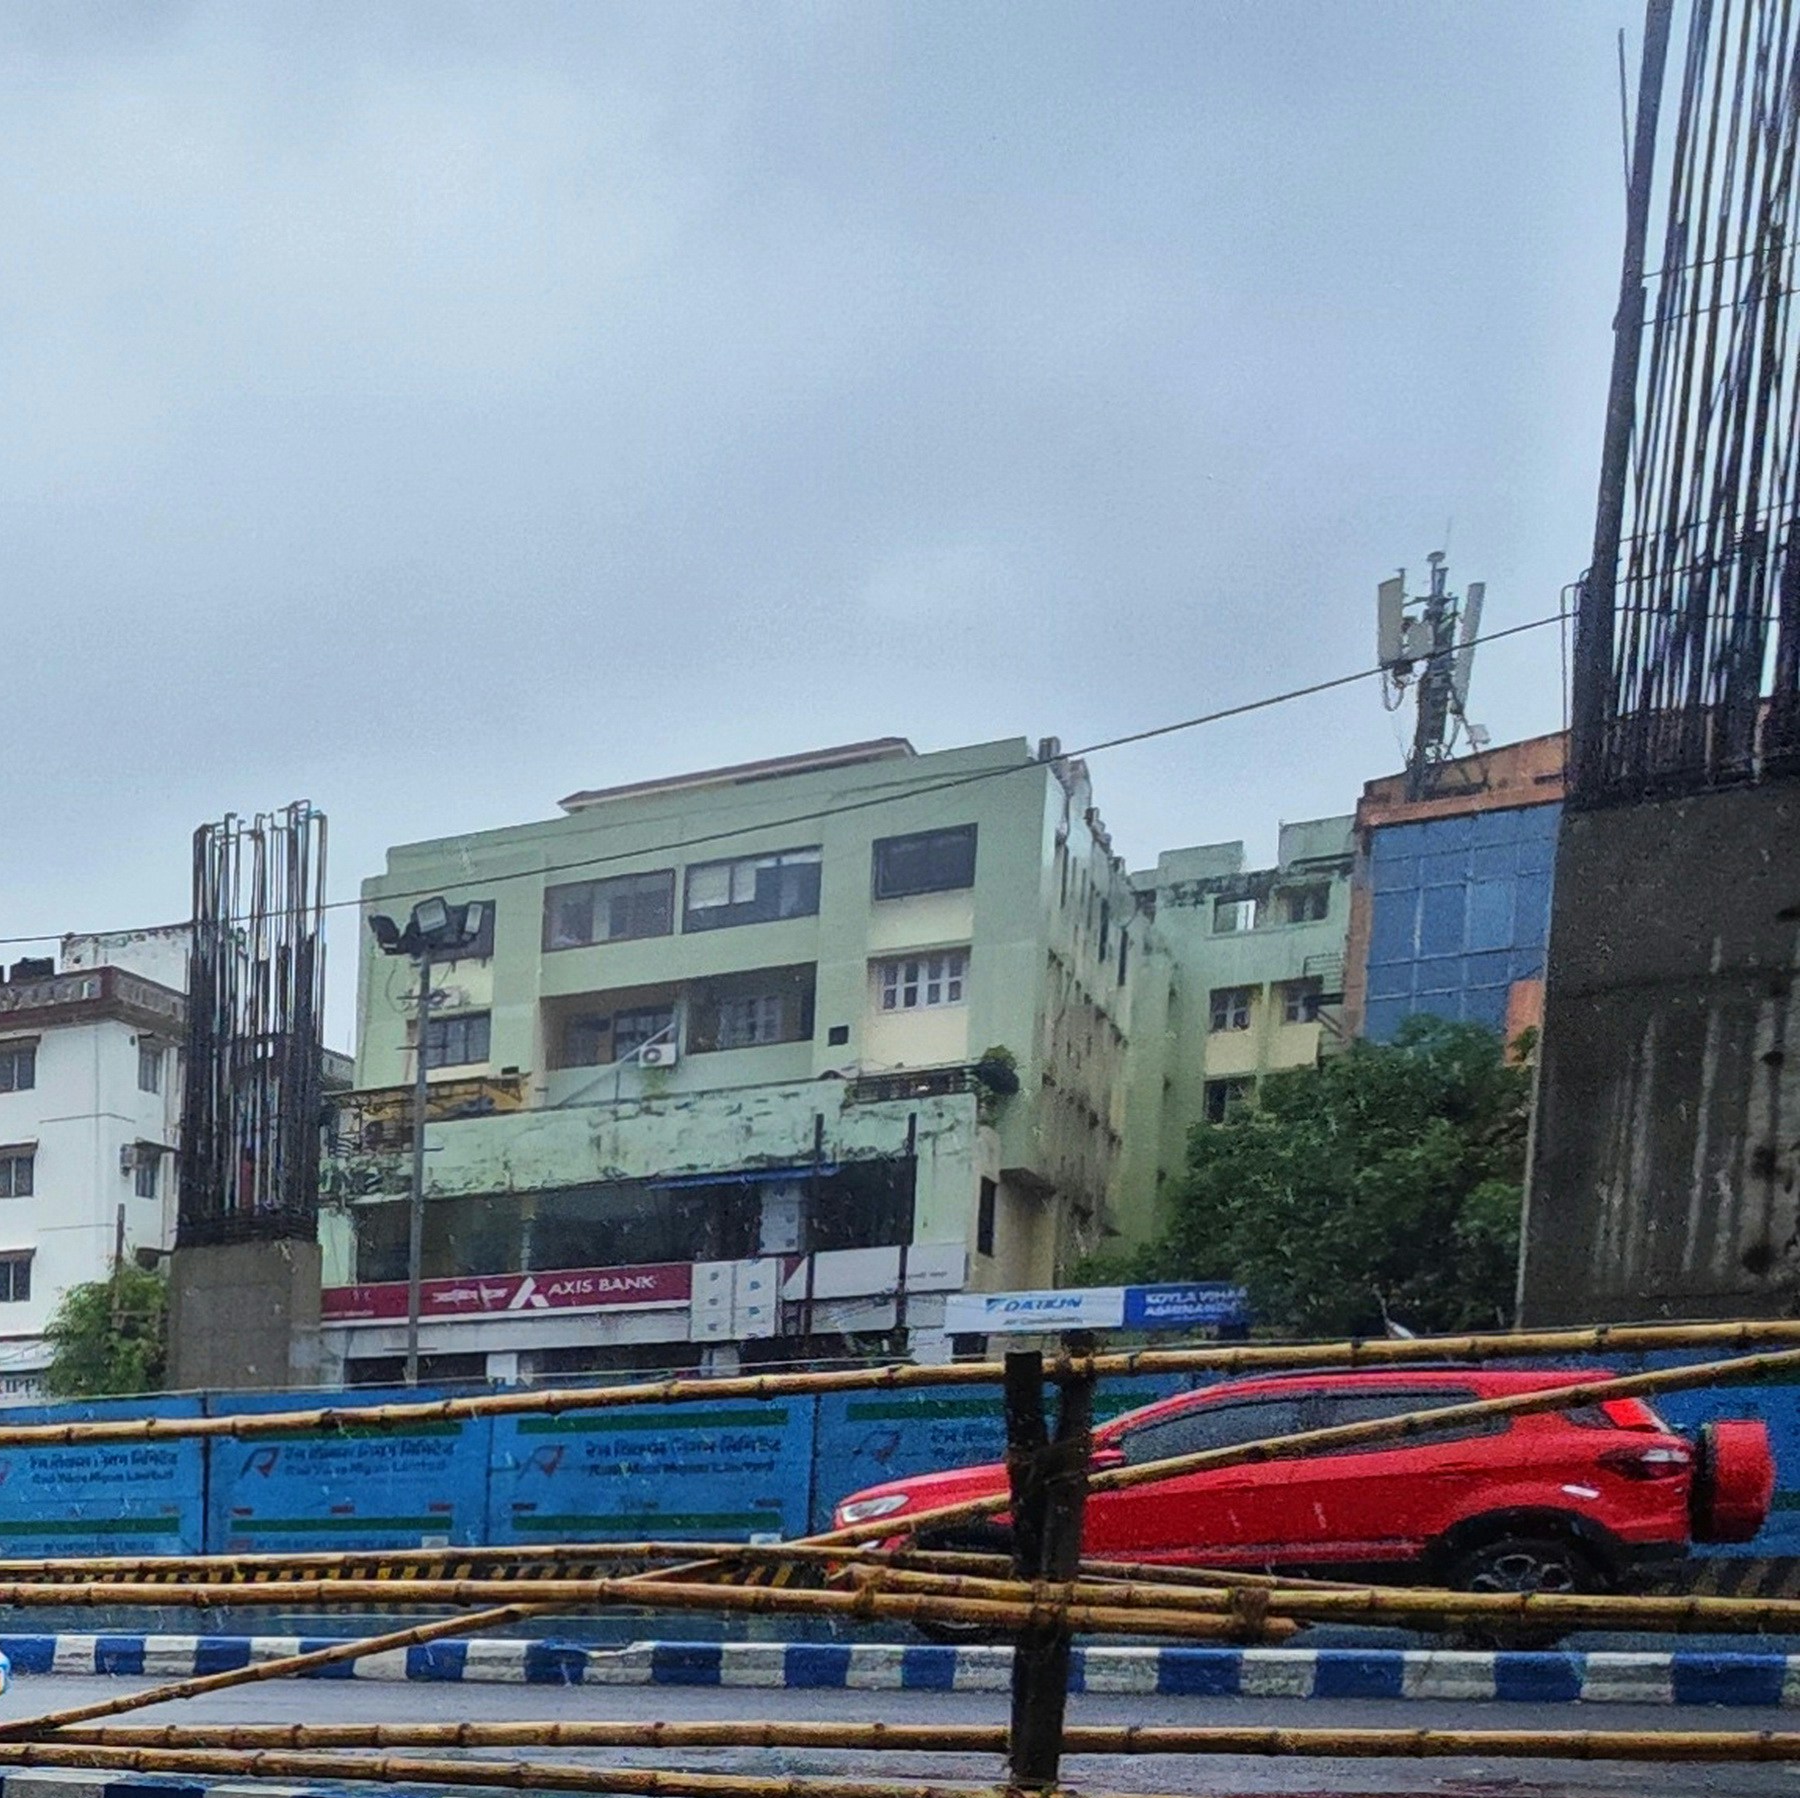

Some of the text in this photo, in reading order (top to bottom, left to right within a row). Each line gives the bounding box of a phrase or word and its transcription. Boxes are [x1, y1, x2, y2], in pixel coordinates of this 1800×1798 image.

[548, 1274, 657, 1297] AXIS BANK
[1005, 1296, 1084, 1312] DAIKIN
